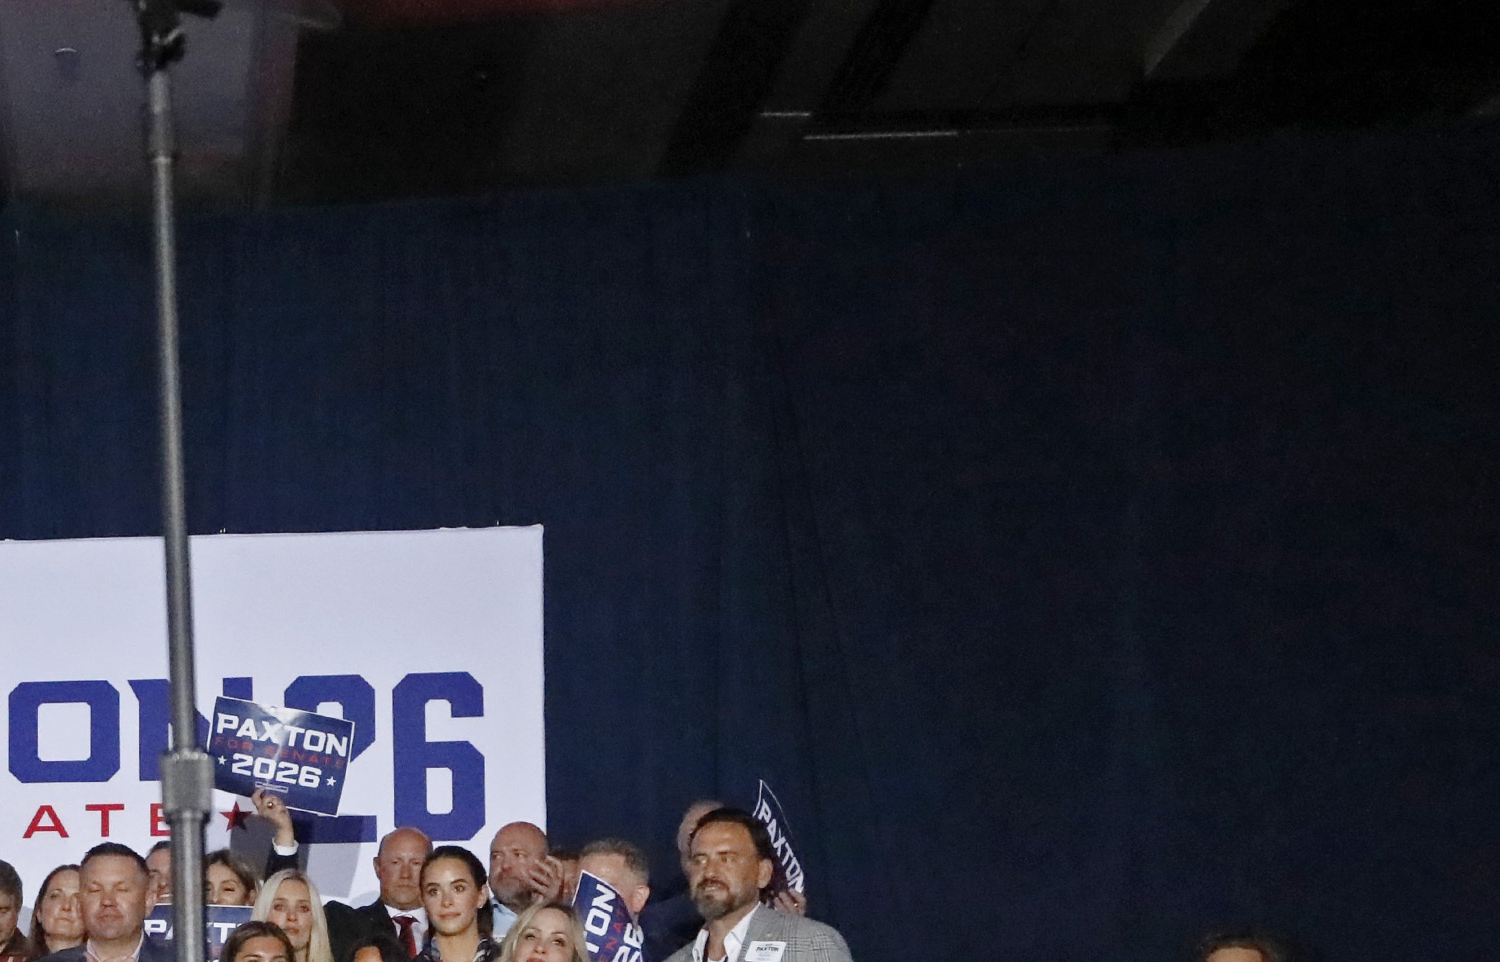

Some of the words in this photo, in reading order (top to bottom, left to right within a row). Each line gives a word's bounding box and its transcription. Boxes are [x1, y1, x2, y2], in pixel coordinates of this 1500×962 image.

[217, 713, 347, 757] PAXTON
[231, 753, 322, 788] 2026
[758, 799, 804, 893] PAXTON
[583, 884, 616, 953] TON
